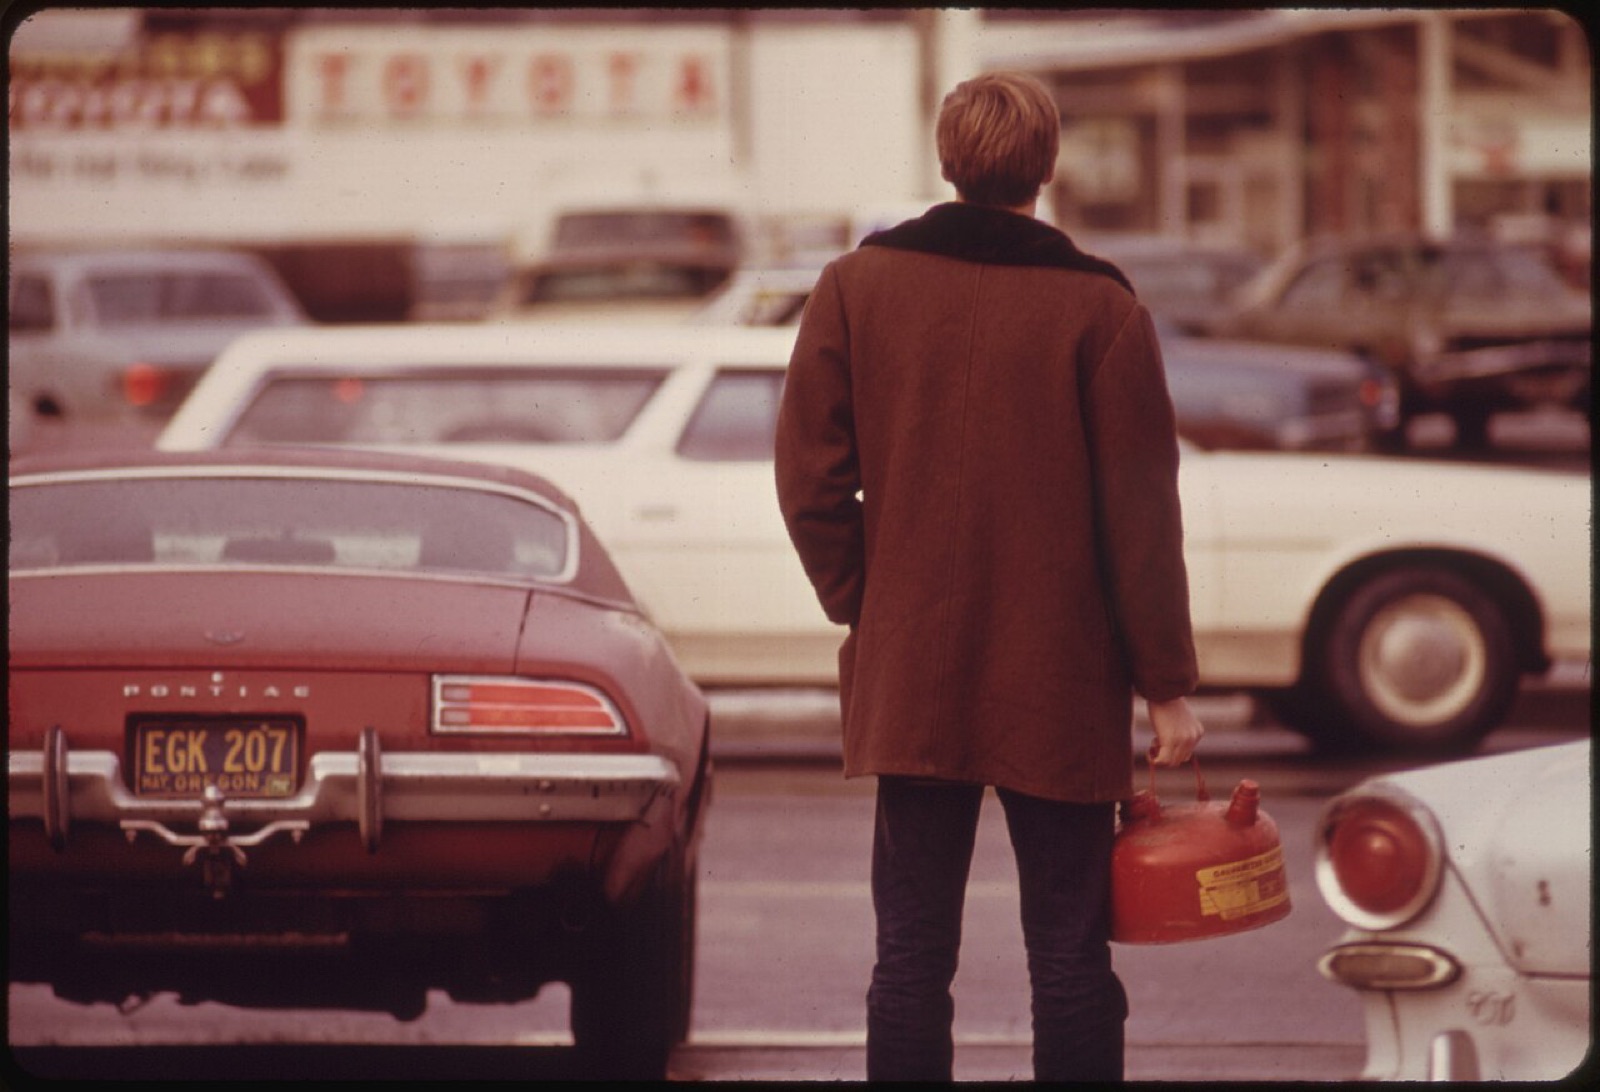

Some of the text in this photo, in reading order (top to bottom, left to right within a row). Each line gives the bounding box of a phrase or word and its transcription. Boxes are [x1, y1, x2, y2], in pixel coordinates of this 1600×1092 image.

[312, 52, 720, 116] TOYOTA
[123, 685, 310, 698] PONTIAC
[145, 729, 288, 773] EGK 207
[174, 774, 259, 791] OREGON
